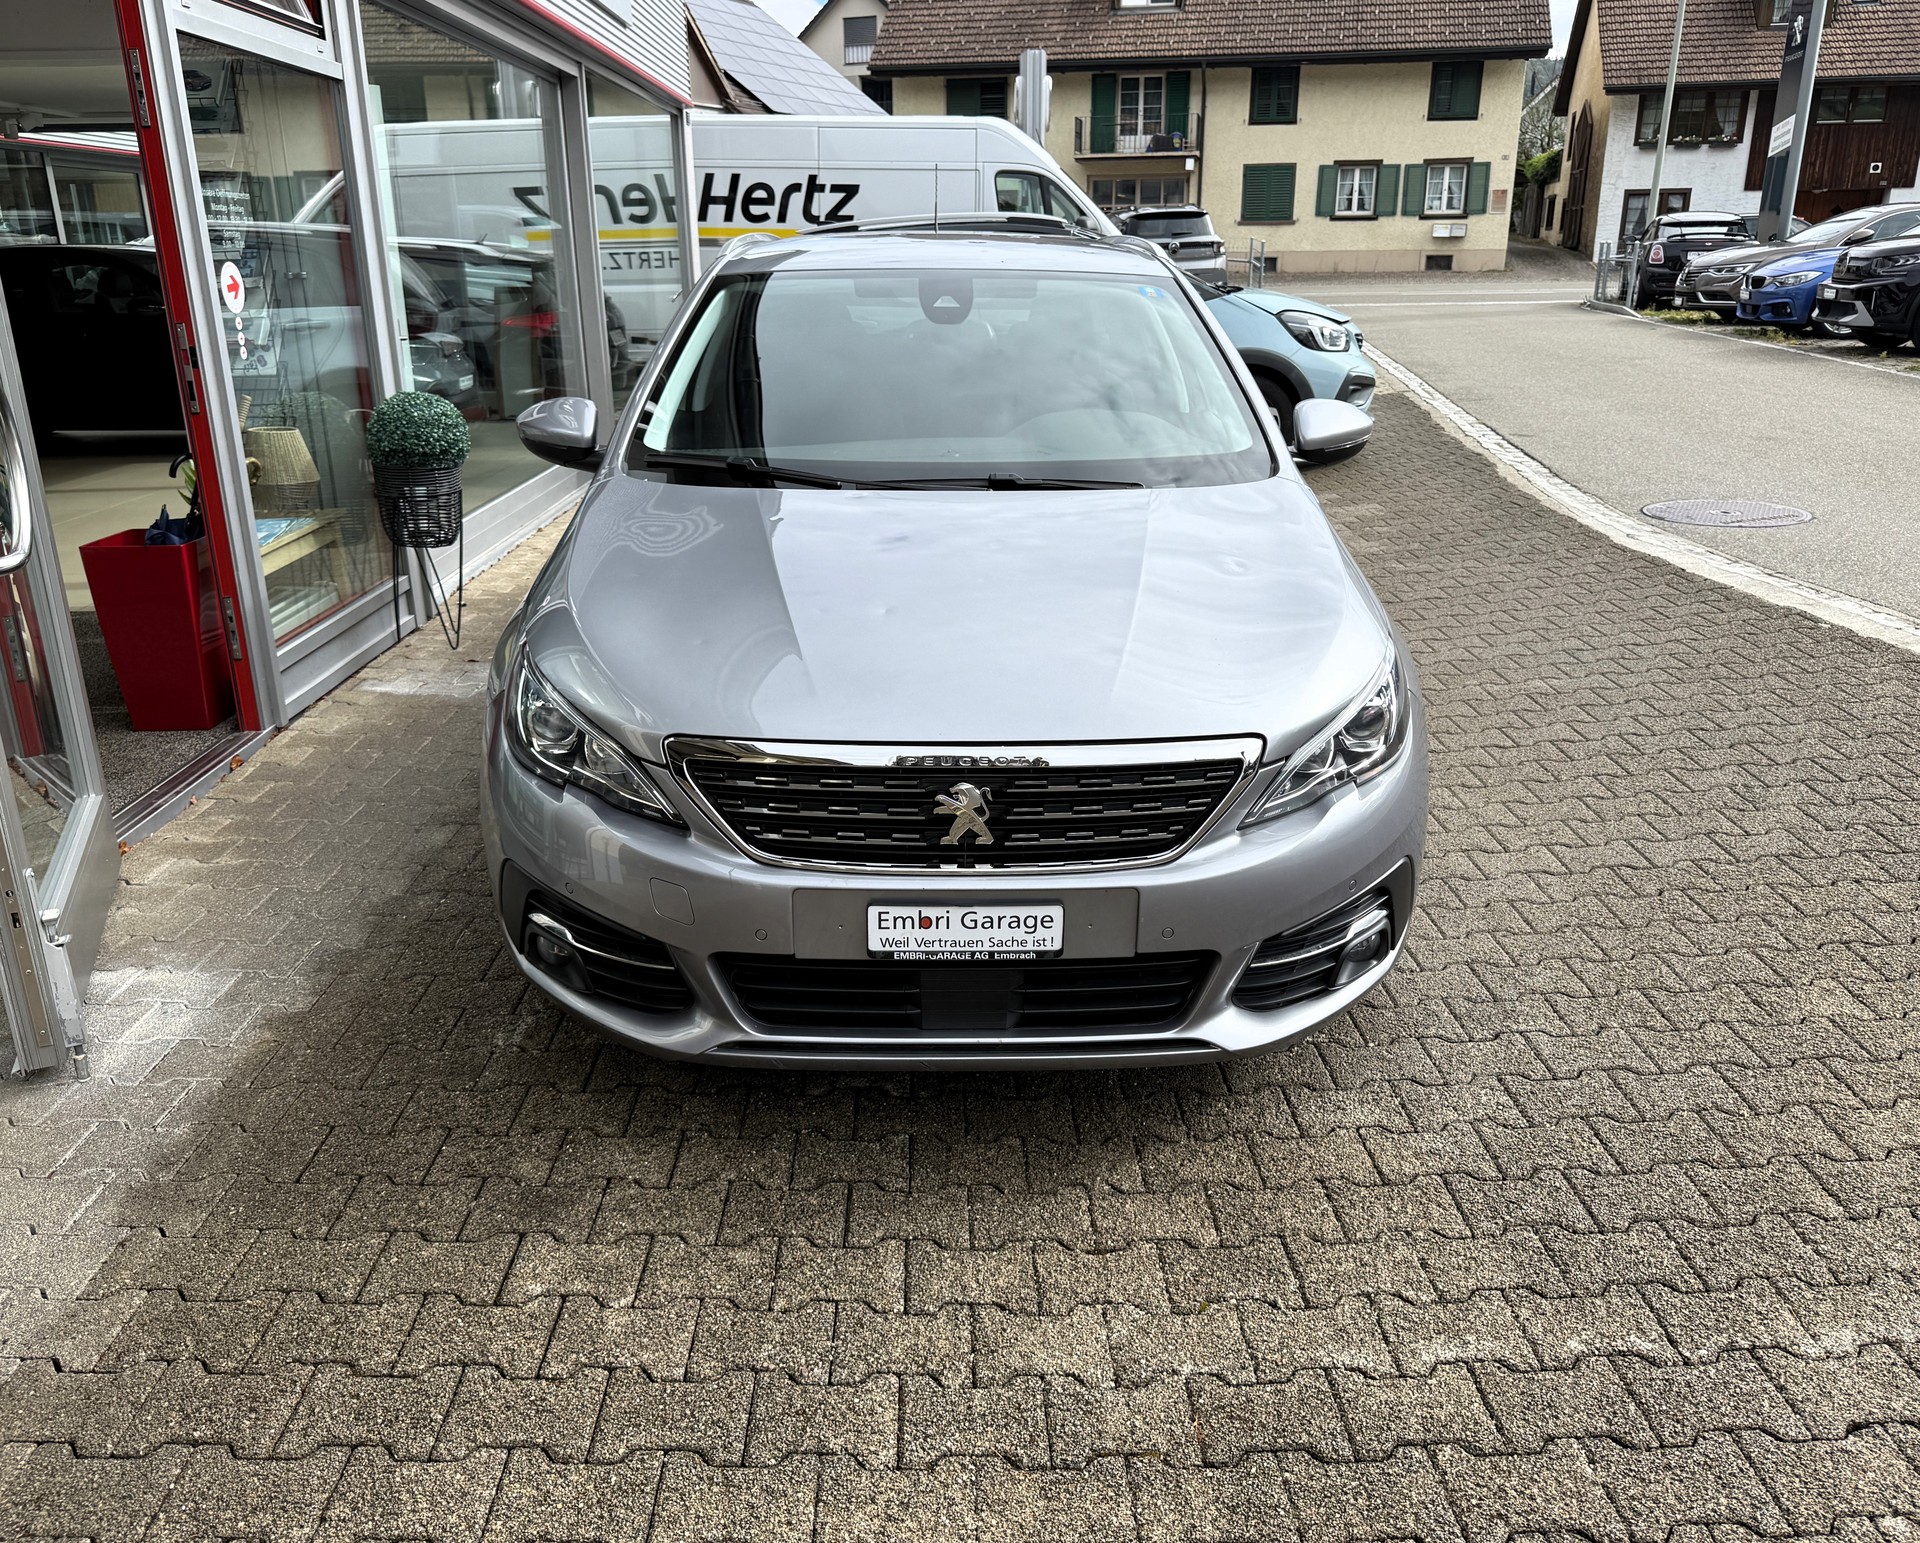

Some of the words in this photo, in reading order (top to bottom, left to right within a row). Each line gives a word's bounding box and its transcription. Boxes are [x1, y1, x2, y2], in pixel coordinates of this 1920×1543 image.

[698, 173, 860, 225] Hertz
[906, 756, 1029, 766] PEUGEOT
[877, 910, 950, 930] Embri
[960, 911, 1055, 934] Garage
[879, 937, 910, 948] Weil
[914, 937, 984, 948] Vertrauen
[988, 936, 1028, 948] Sache
[974, 952, 989, 960] AG
